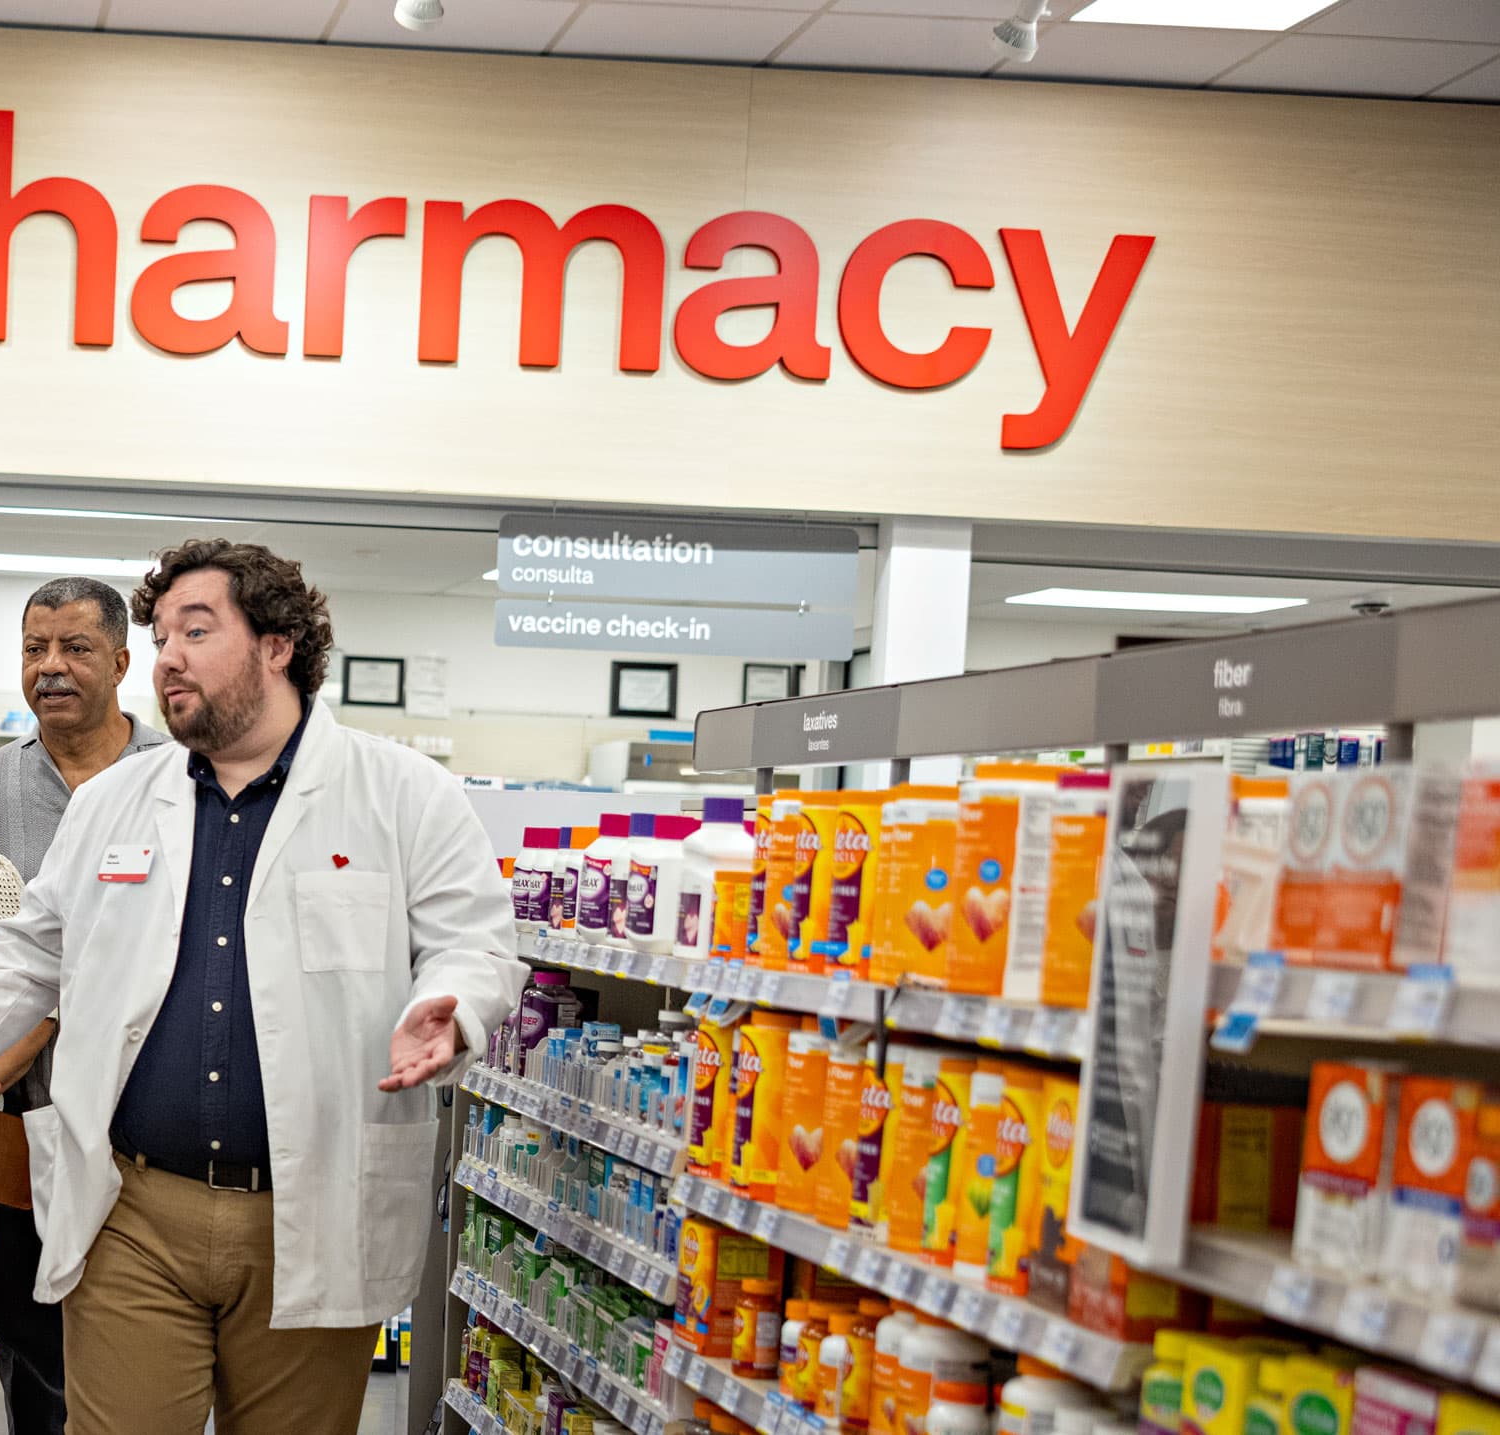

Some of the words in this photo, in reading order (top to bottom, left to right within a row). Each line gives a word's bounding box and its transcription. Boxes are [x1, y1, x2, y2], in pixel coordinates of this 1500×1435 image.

[512, 531, 713, 564] consultation
[512, 566, 594, 584] consulta
[508, 612, 601, 635] vaccine
[606, 614, 711, 640] check-in
[1213, 659, 1252, 688] fiber
[803, 710, 838, 731] laxatives
[464, 777, 492, 786] Please
[835, 827, 870, 851] eta
